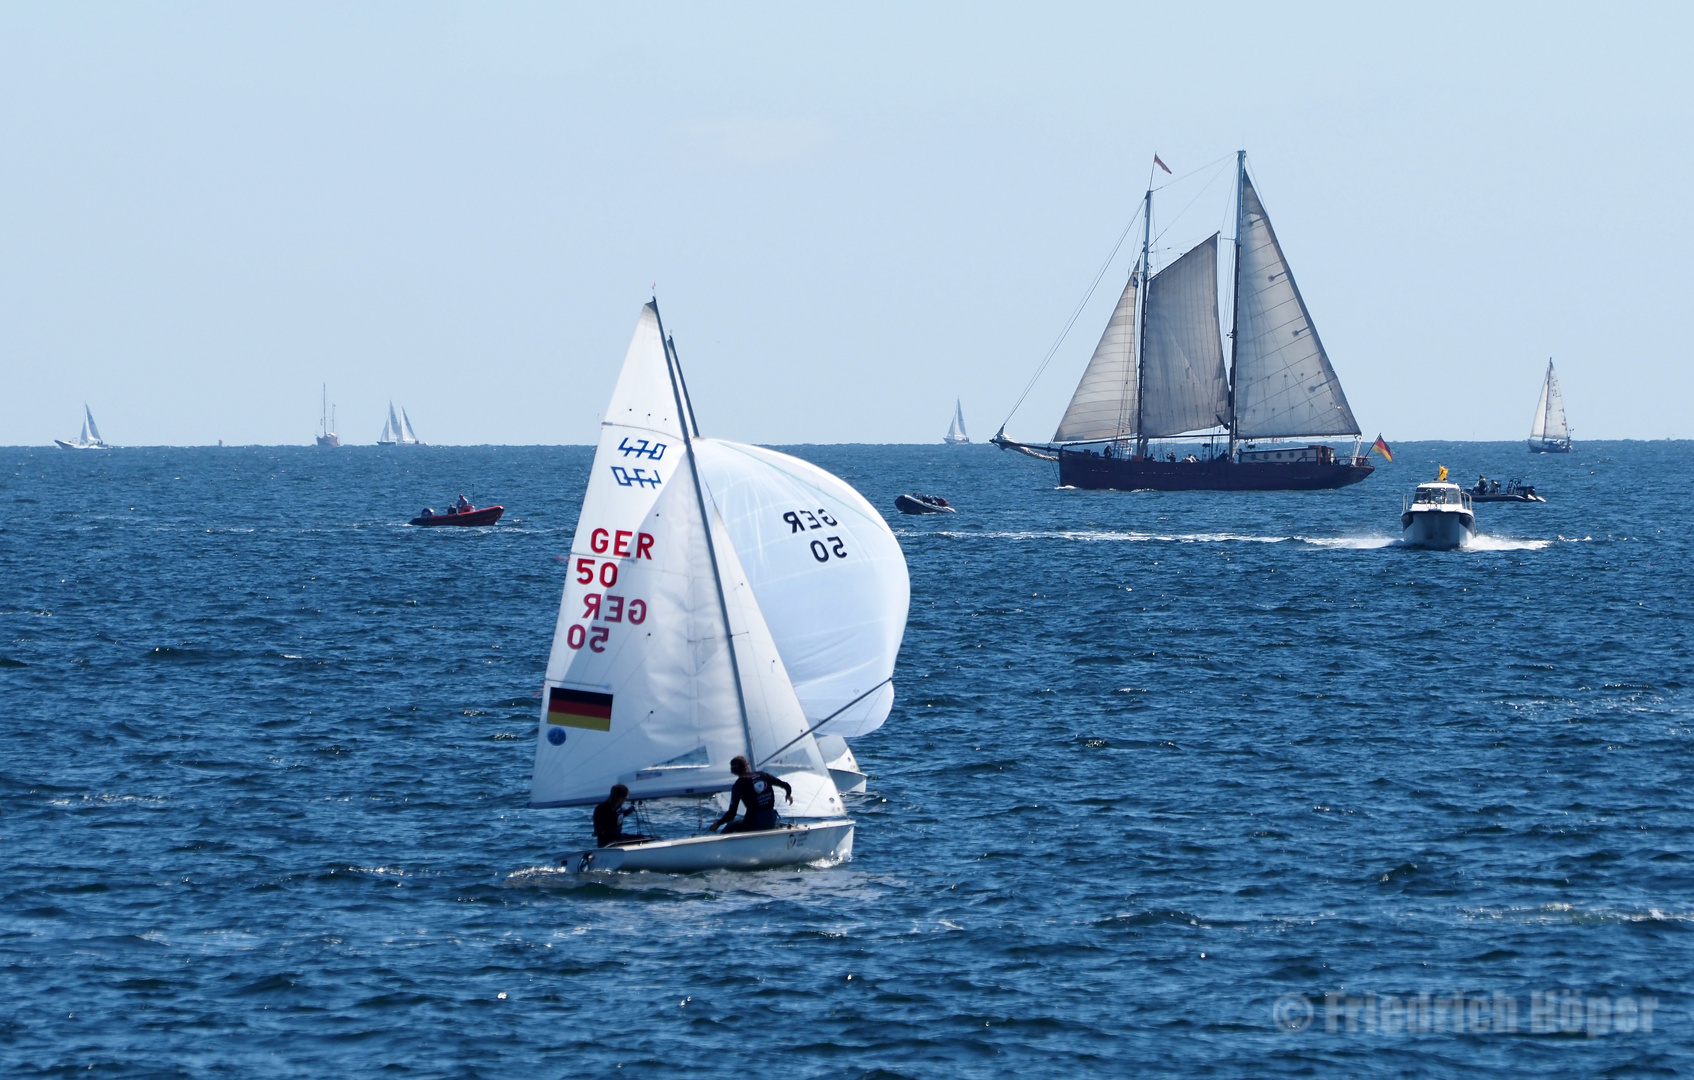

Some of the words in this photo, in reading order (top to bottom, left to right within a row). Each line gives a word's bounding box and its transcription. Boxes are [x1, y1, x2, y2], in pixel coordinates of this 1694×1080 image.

[618, 437, 667, 460] 470
[590, 528, 655, 560] GER
[576, 558, 618, 588] 50
